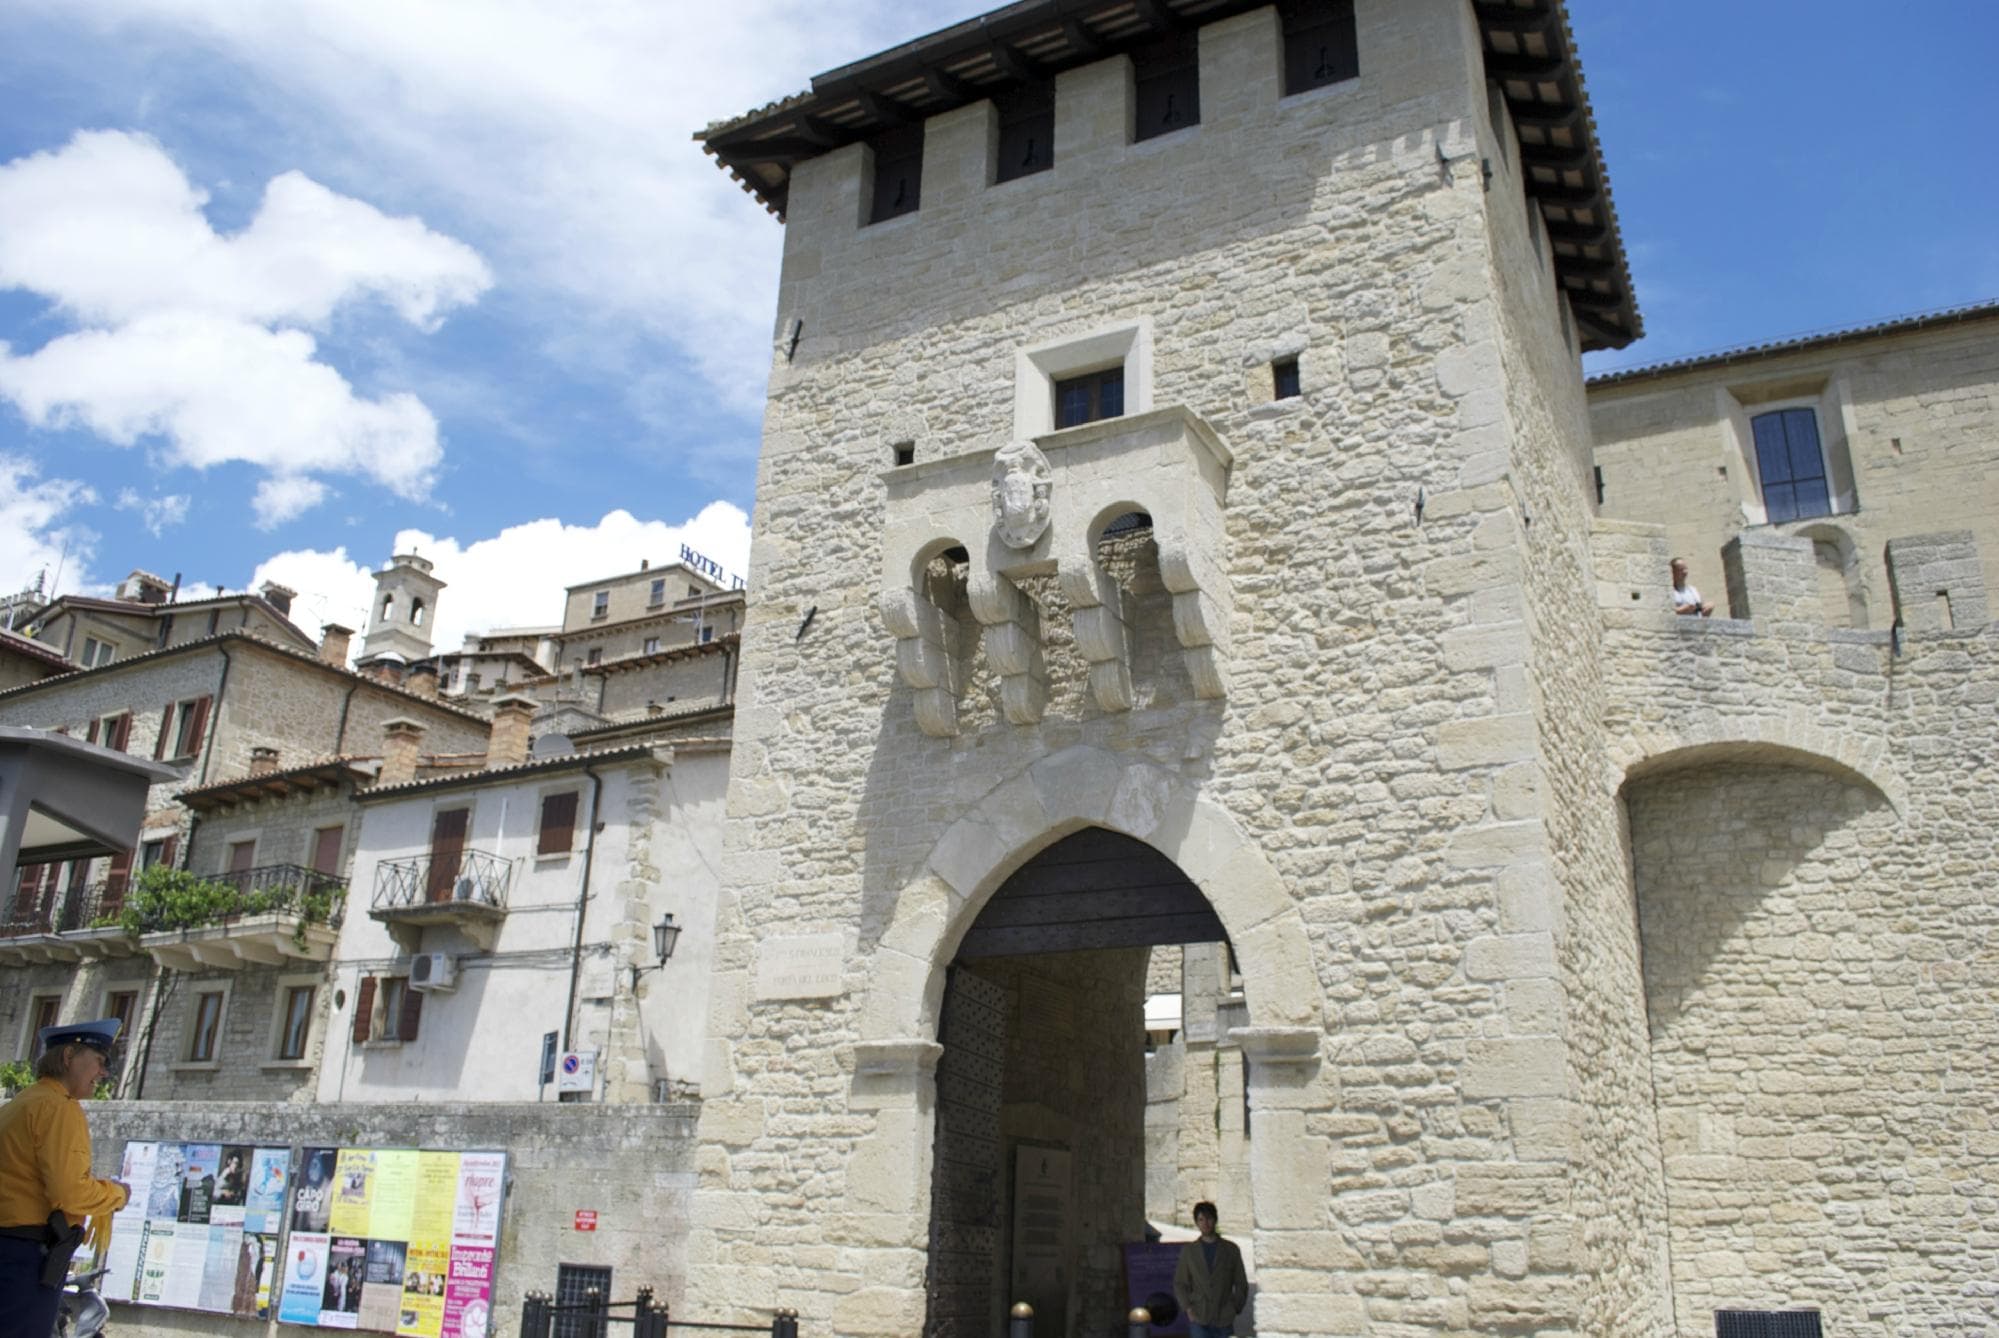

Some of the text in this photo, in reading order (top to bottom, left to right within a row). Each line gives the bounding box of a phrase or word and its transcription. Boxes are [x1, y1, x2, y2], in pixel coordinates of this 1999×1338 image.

[679, 542, 748, 591] HOTEL TI
[297, 1185, 324, 1202] CAPO
[295, 1199, 321, 1212] GIRO
